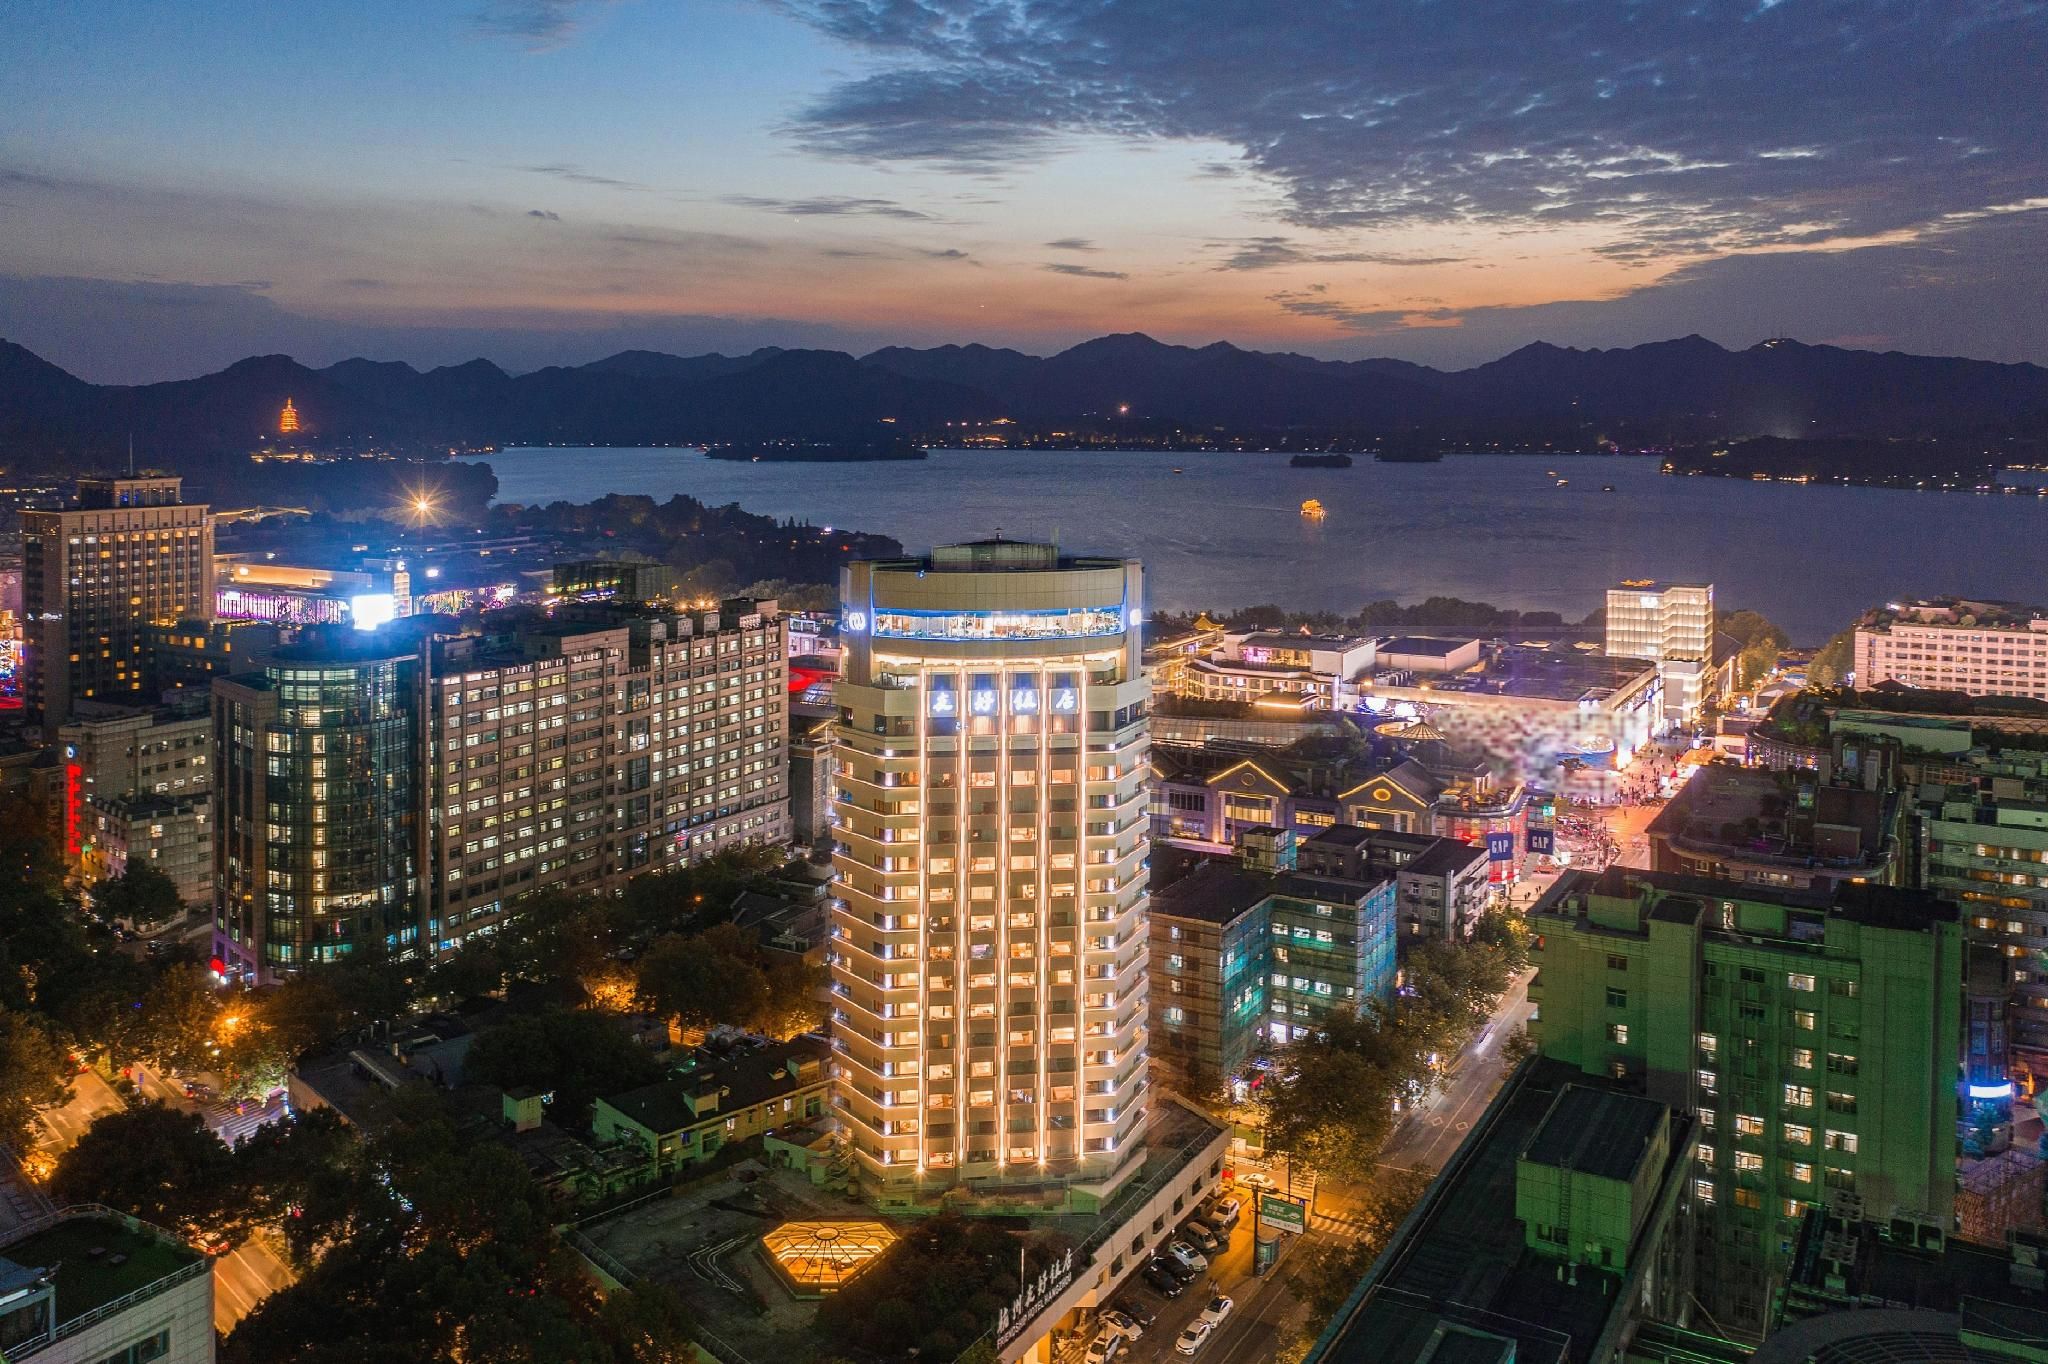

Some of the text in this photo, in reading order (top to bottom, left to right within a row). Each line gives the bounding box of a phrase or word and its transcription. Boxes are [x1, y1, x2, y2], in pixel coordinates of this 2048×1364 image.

[1491, 839, 1509, 853] GAP
[1532, 836, 1550, 848] GAP
[1027, 1301, 1045, 1321] HOTEL
